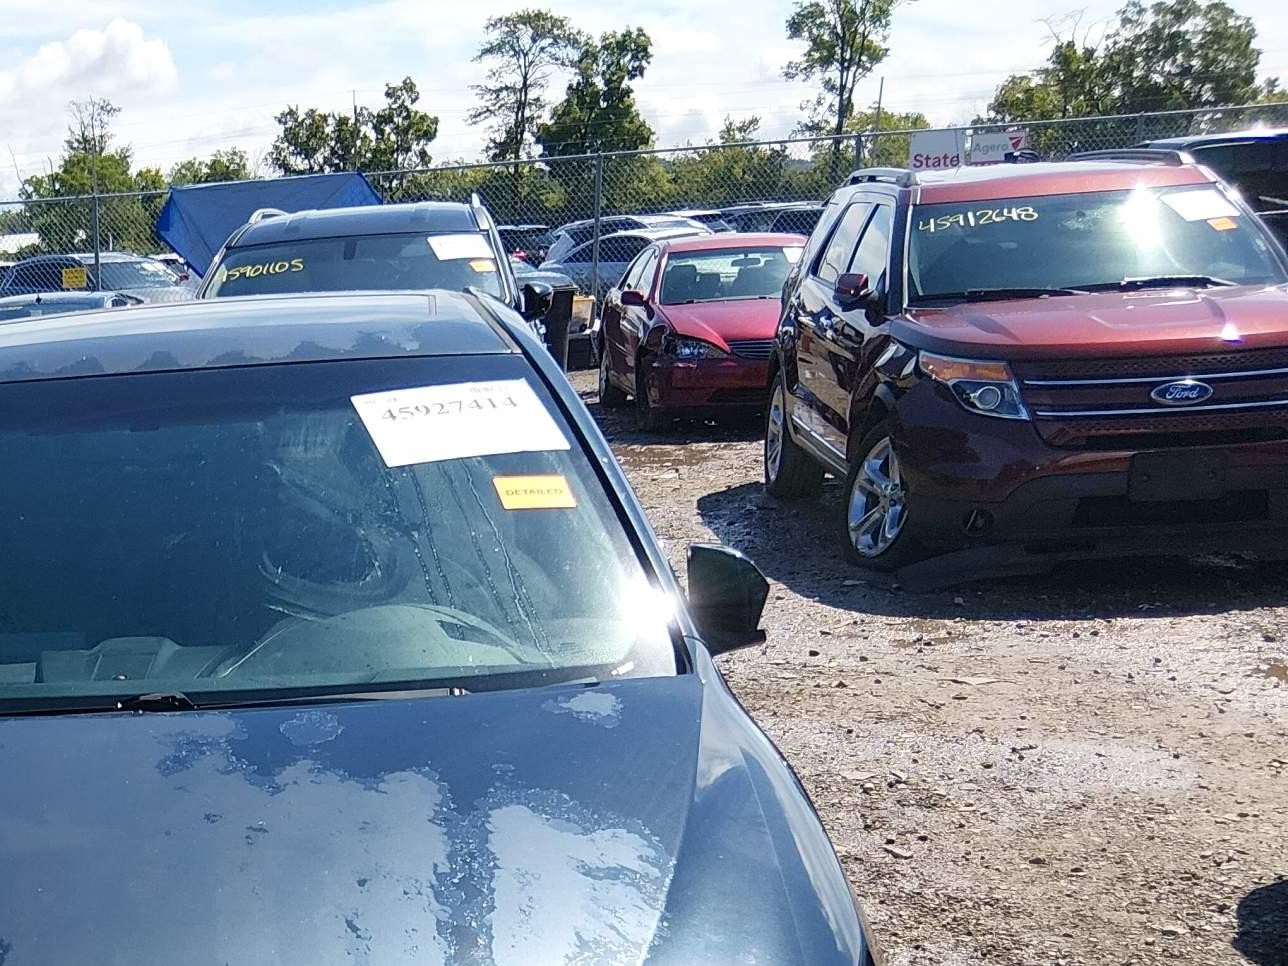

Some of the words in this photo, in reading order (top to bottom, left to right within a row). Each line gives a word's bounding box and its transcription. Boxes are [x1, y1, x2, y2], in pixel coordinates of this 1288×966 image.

[973, 143, 1009, 155] Agero
[913, 153, 961, 169] State
[918, 206, 1039, 233] 45912648
[1165, 384, 1200, 399] Ford
[381, 396, 518, 423] 45927414
[505, 488, 563, 497] DETAILED
